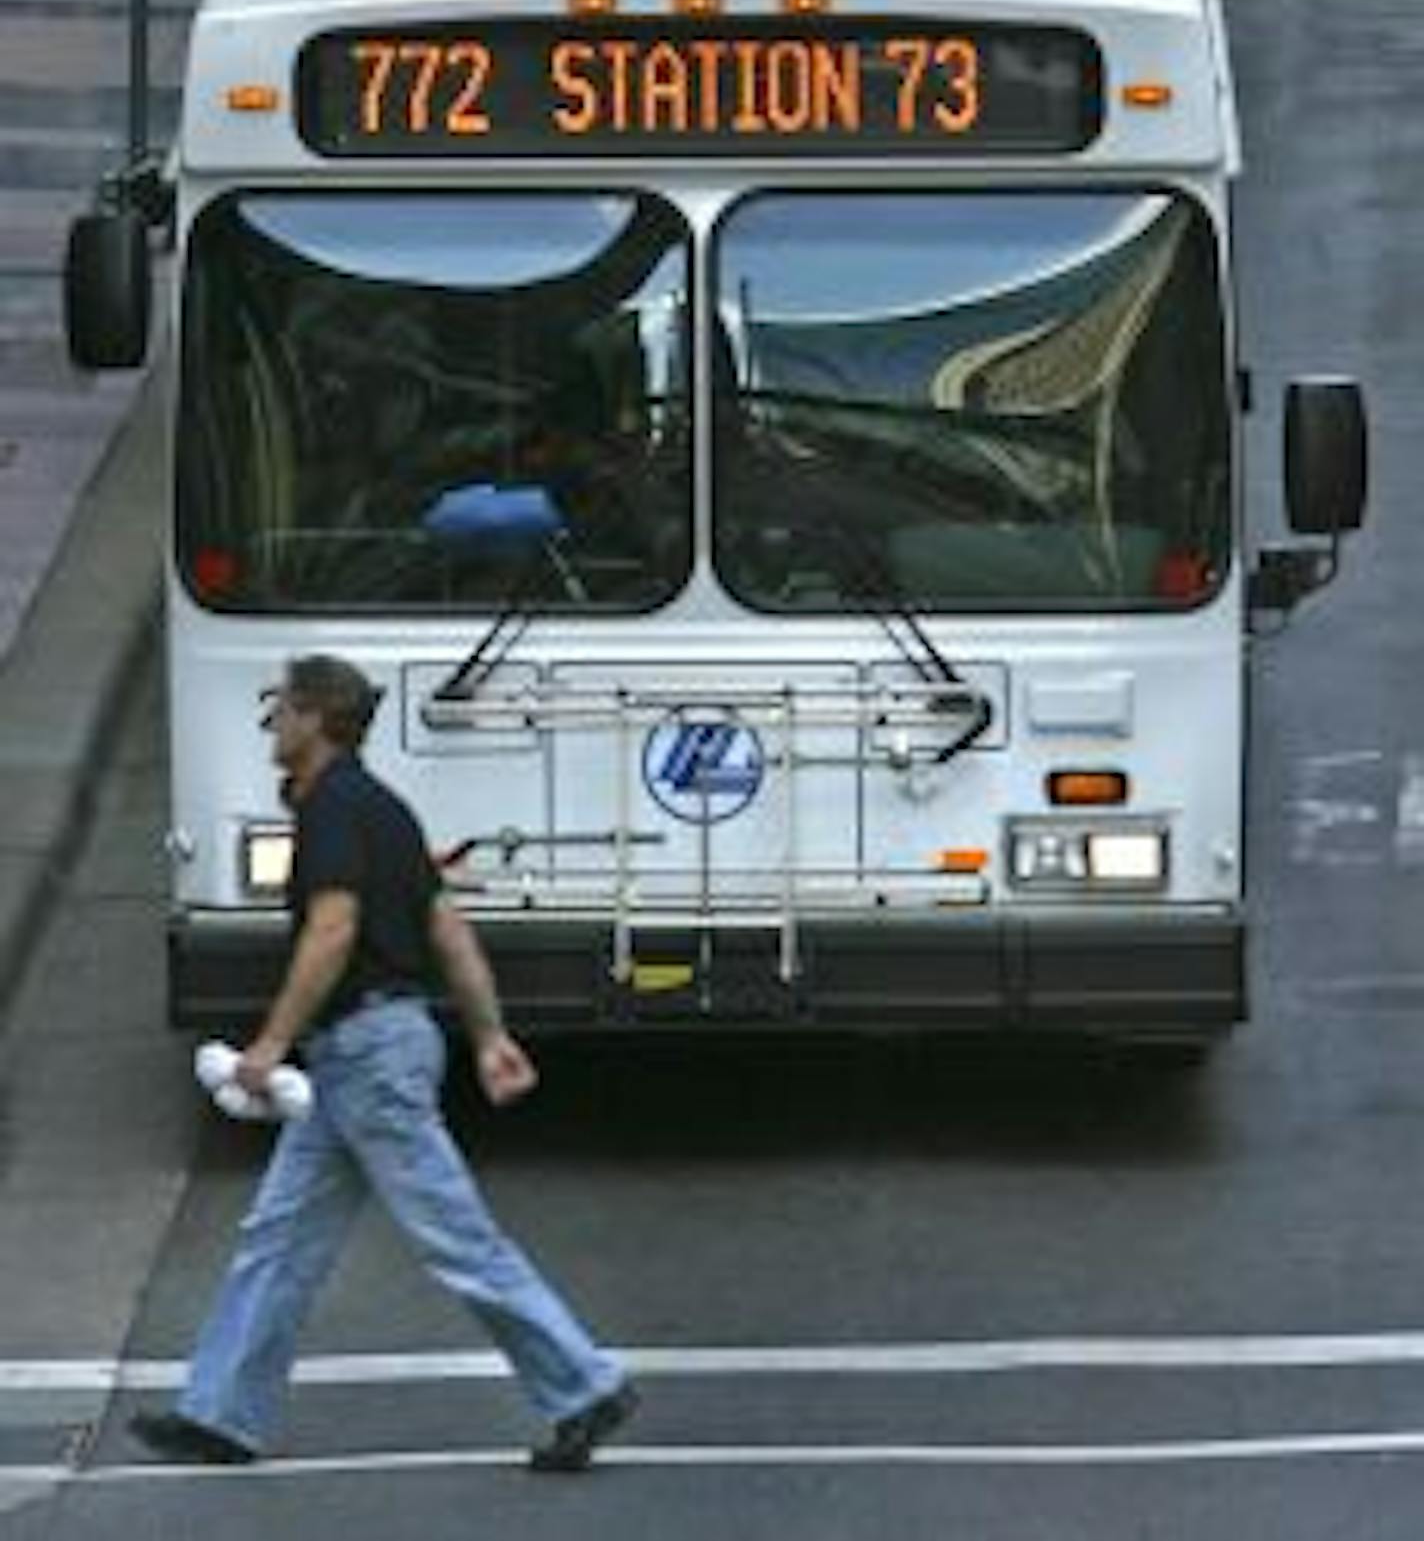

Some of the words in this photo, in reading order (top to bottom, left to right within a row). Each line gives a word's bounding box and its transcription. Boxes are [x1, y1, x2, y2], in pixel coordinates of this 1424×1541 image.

[352, 39, 491, 133] 772
[551, 39, 860, 133] STATION
[885, 39, 979, 133] 73
